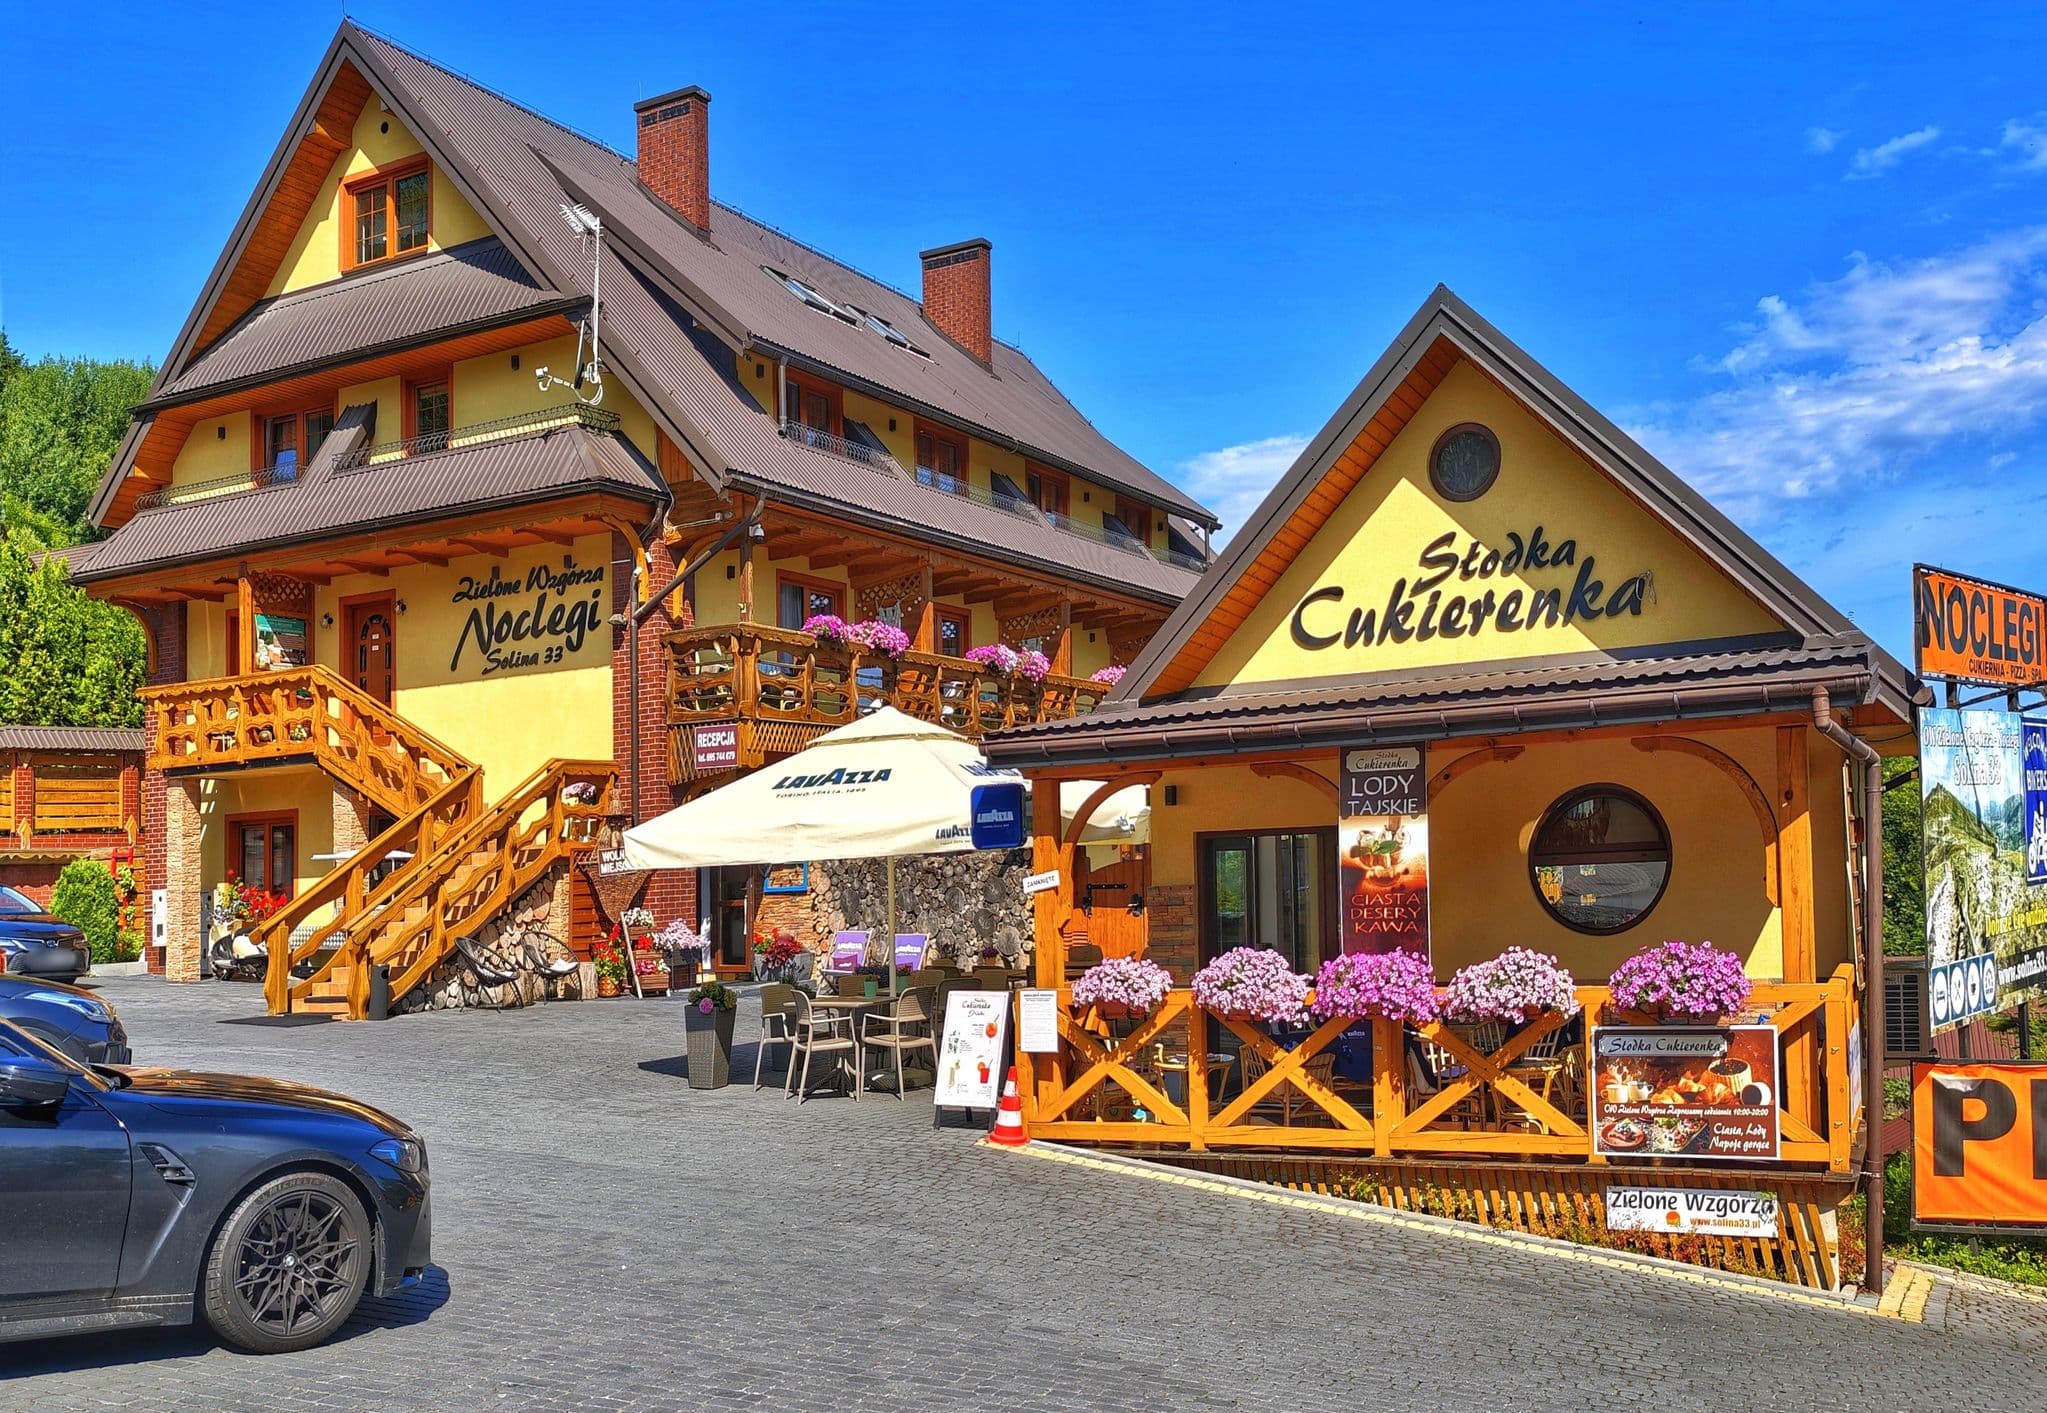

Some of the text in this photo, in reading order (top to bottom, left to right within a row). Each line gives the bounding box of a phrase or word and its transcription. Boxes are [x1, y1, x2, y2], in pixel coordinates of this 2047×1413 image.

[1409, 526, 1577, 598] Słodka
[452, 563, 604, 602] Zielone Wzgórza
[1290, 557, 1644, 651] Cukierenka
[451, 589, 601, 672] Noclegi
[1922, 579, 2041, 665] NOCLEGI
[482, 646, 563, 675] Solina 33
[1969, 658, 2005, 676] CUKIERNIA
[2010, 665, 2027, 681] PIZZA
[697, 731, 736, 748] RECEPCJA
[1356, 757, 1408, 770] Cukierenka
[771, 768, 892, 789] LAVAZZA
[1351, 774, 1414, 797] LODY
[1348, 798, 1418, 816] TAJSKIE
[936, 824, 972, 839] LAVAZZ
[601, 850, 625, 862] WOLN
[1352, 893, 1420, 908] CIASTA
[1351, 907, 1421, 920] DESERY
[1354, 921, 1418, 933] KAWA
[1608, 1038, 1721, 1053] Słodka Cukierenka
[1713, 1122, 1767, 1139] Ciasta, Lody
[1709, 1136, 1770, 1152] Napoje gorące
[1611, 1191, 1774, 1218] Zielone Wzgórza
[1690, 1217, 1761, 1229] www.solina33.pl
